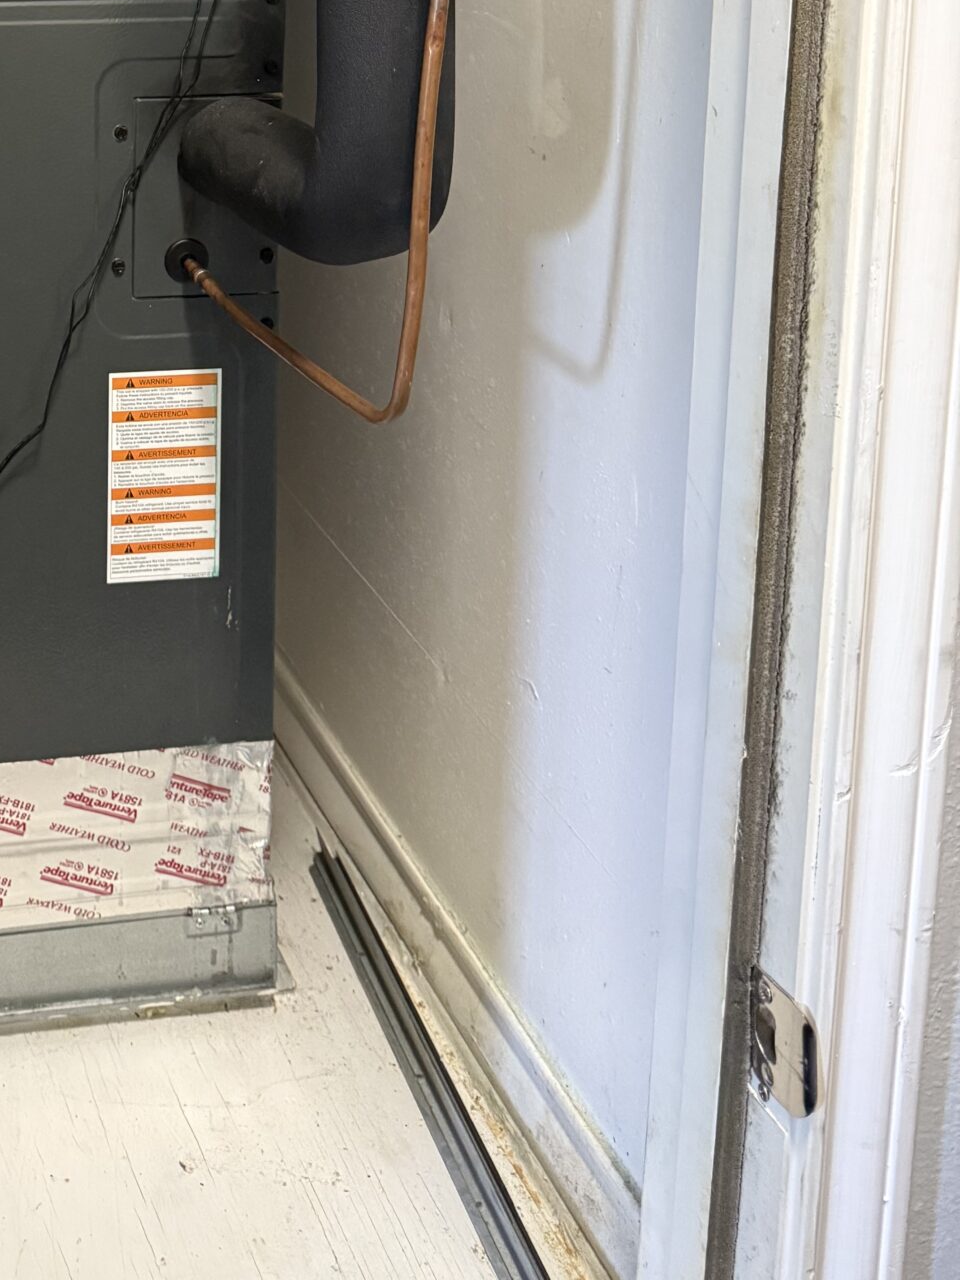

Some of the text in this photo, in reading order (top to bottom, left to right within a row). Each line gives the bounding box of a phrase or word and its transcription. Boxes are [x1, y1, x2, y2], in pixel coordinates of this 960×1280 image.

[138, 377, 173, 385] WARNING
[139, 410, 189, 419] ADVERTENCIA
[138, 448, 197, 458] AVERTISSEMENT
[137, 488, 172, 496] WARNING
[137, 513, 187, 522] ADVERTENCIA
[137, 541, 196, 551] AVERTISSEMENT
[201, 752, 246, 772] WEATHER
[127, 765, 156, 779] COLD
[111, 790, 143, 807] 1581A
[170, 780, 228, 803] ntureTape
[65, 791, 138, 819] VentureTape
[49, 822, 95, 841] WEATHER
[42, 865, 114, 894] VentureTape
[87, 864, 119, 881] 1581A
[156, 858, 227, 885] VentureTape
